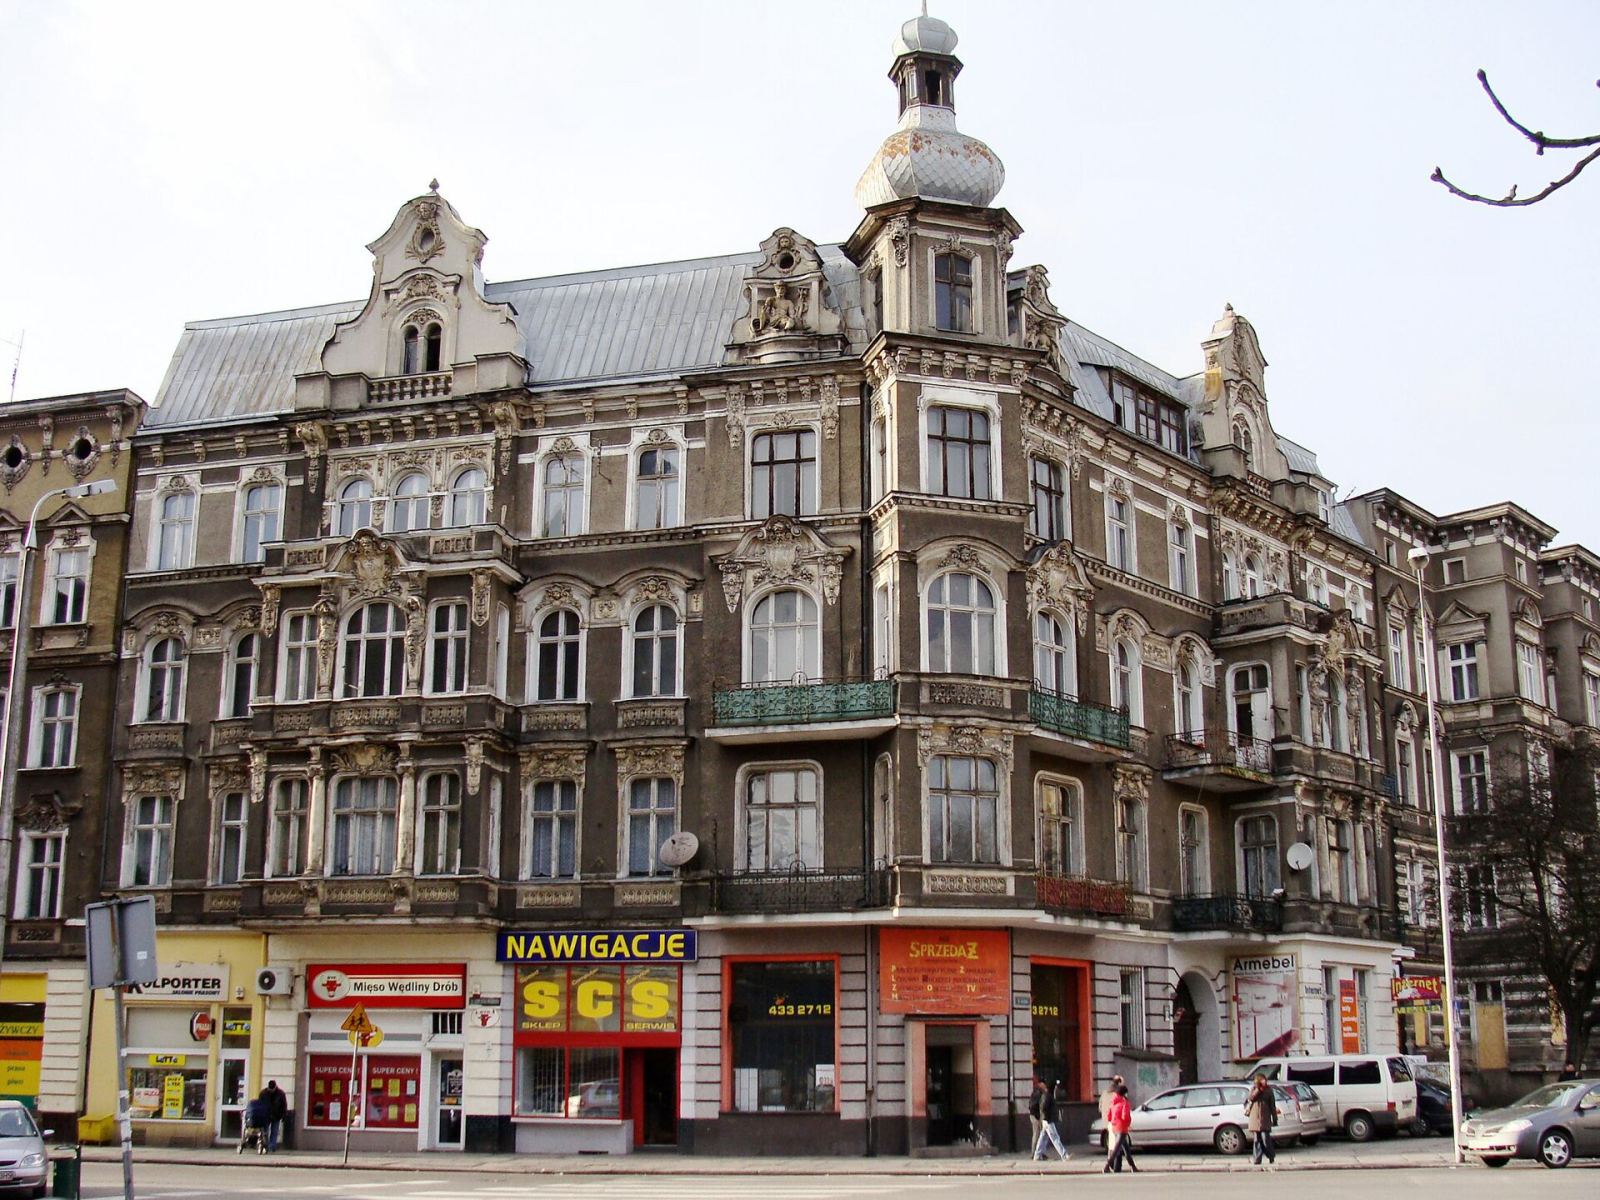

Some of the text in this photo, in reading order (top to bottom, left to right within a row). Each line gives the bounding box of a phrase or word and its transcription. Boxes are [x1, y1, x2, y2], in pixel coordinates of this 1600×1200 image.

[506, 933, 685, 959] NAWIGACJE
[1233, 954, 1294, 971] Armebel
[353, 979, 458, 994] Mięso Wędliny Drób
[1392, 977, 1438, 997] Internet
[768, 1004, 831, 1015] 433 2712
[521, 1021, 561, 1029] SKLEP
[626, 1021, 676, 1030] SERWIS
[314, 1066, 337, 1074] SUPER
[372, 1067, 395, 1075] SUPER
